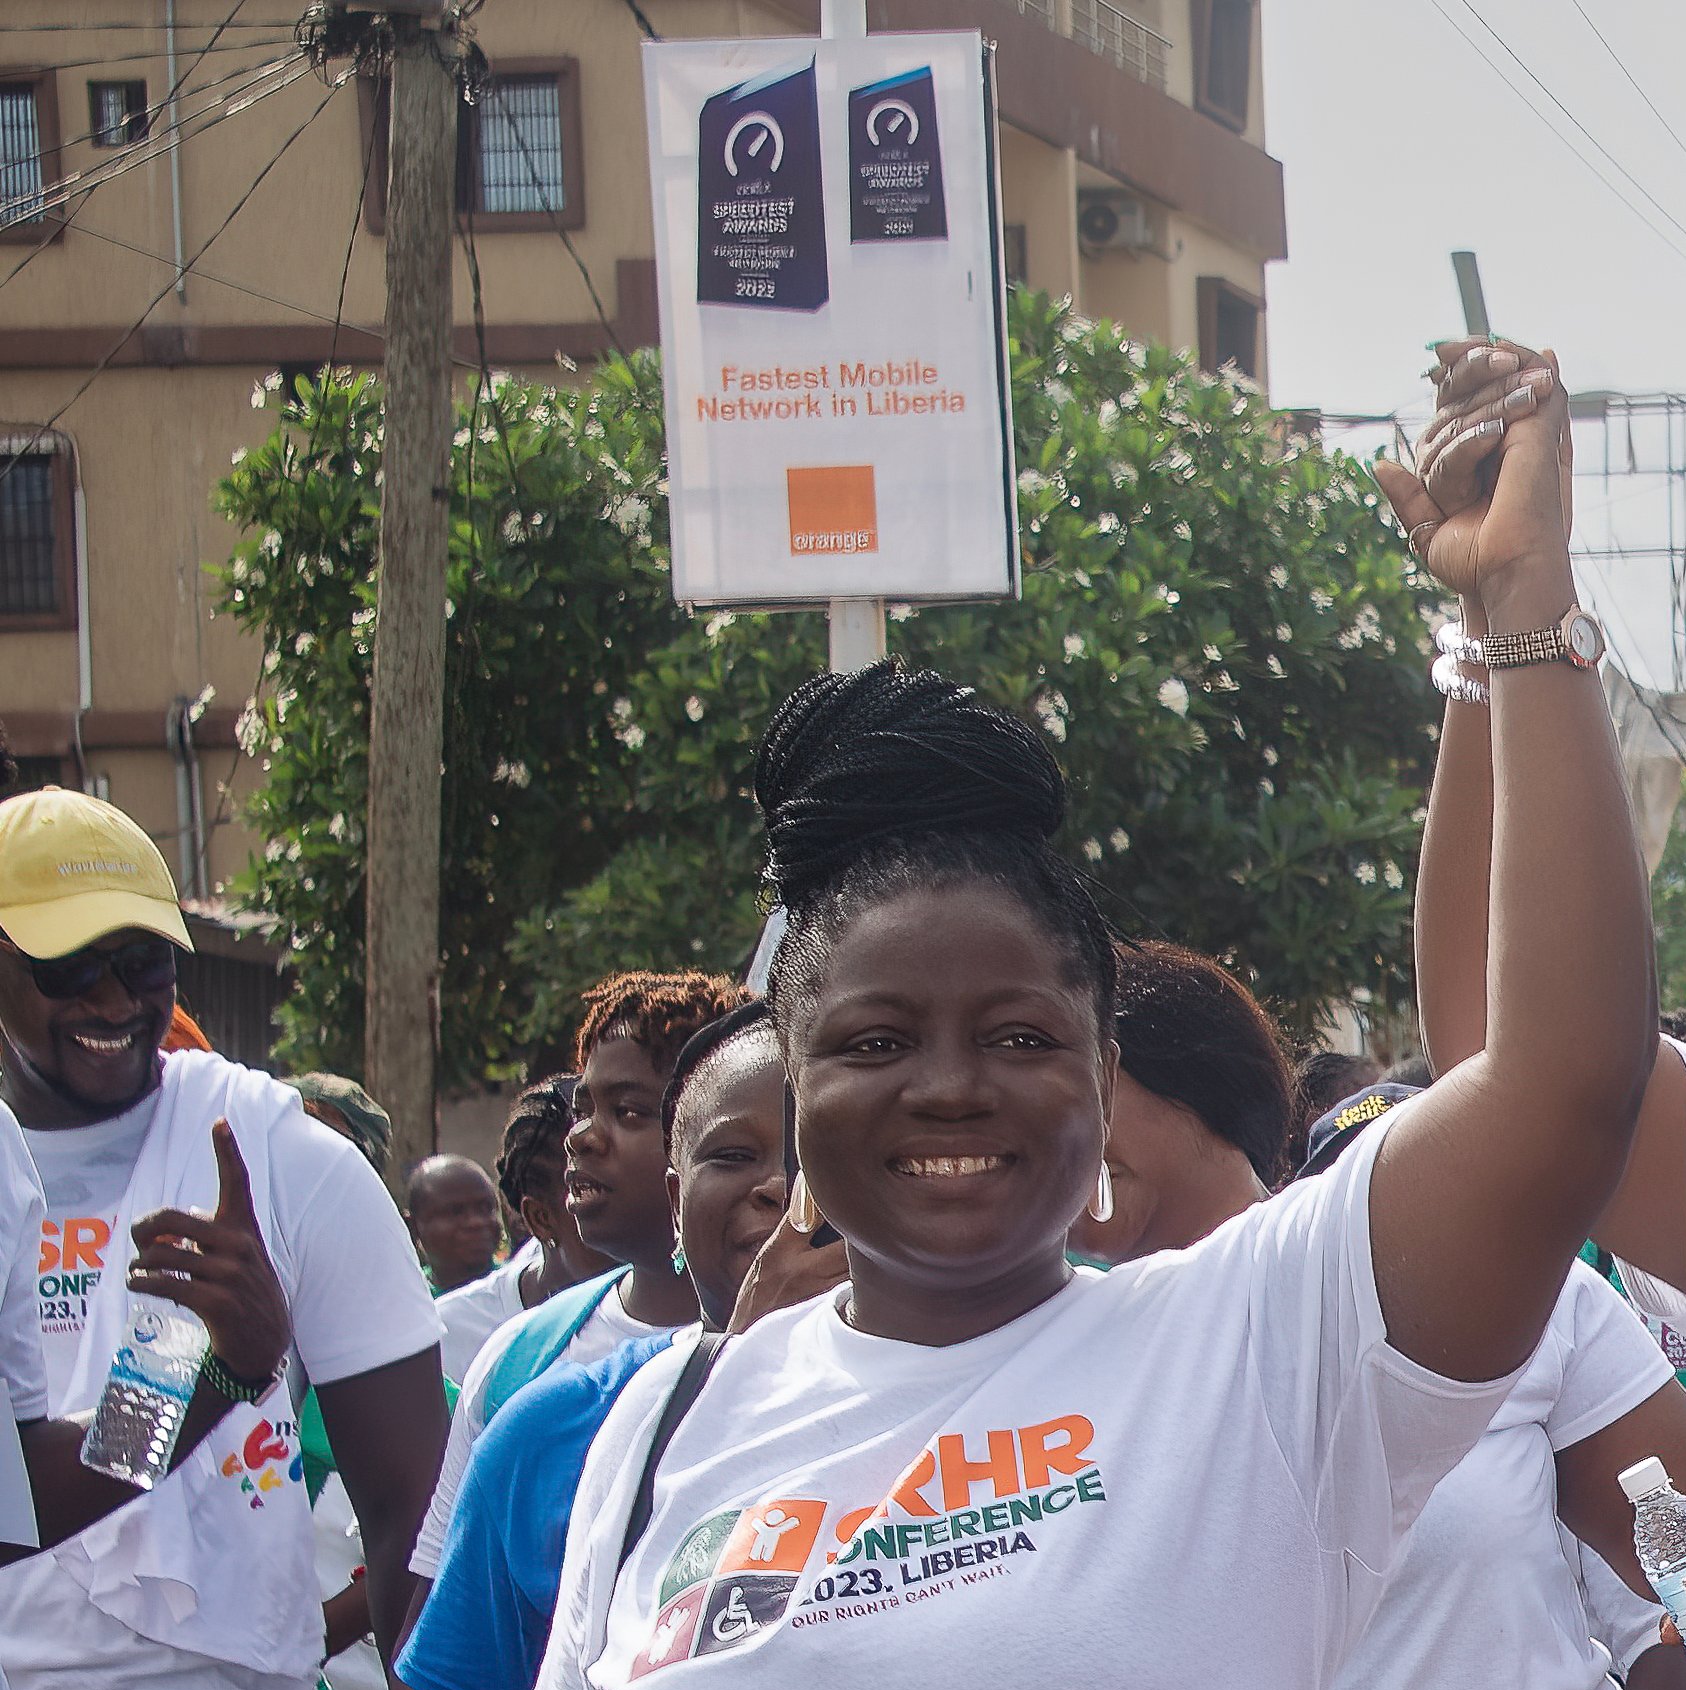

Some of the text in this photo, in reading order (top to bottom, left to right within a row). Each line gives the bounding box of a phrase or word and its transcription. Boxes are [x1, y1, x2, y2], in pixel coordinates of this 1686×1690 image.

[721, 359, 938, 393] Fastest Mobile
[697, 389, 967, 423] Network in Liberia
[793, 529, 871, 553] orange
[899, 1531, 1038, 1586] LIBERIA
[791, 1607, 830, 1630] OUR
[904, 1579, 956, 1605] CAN'T
